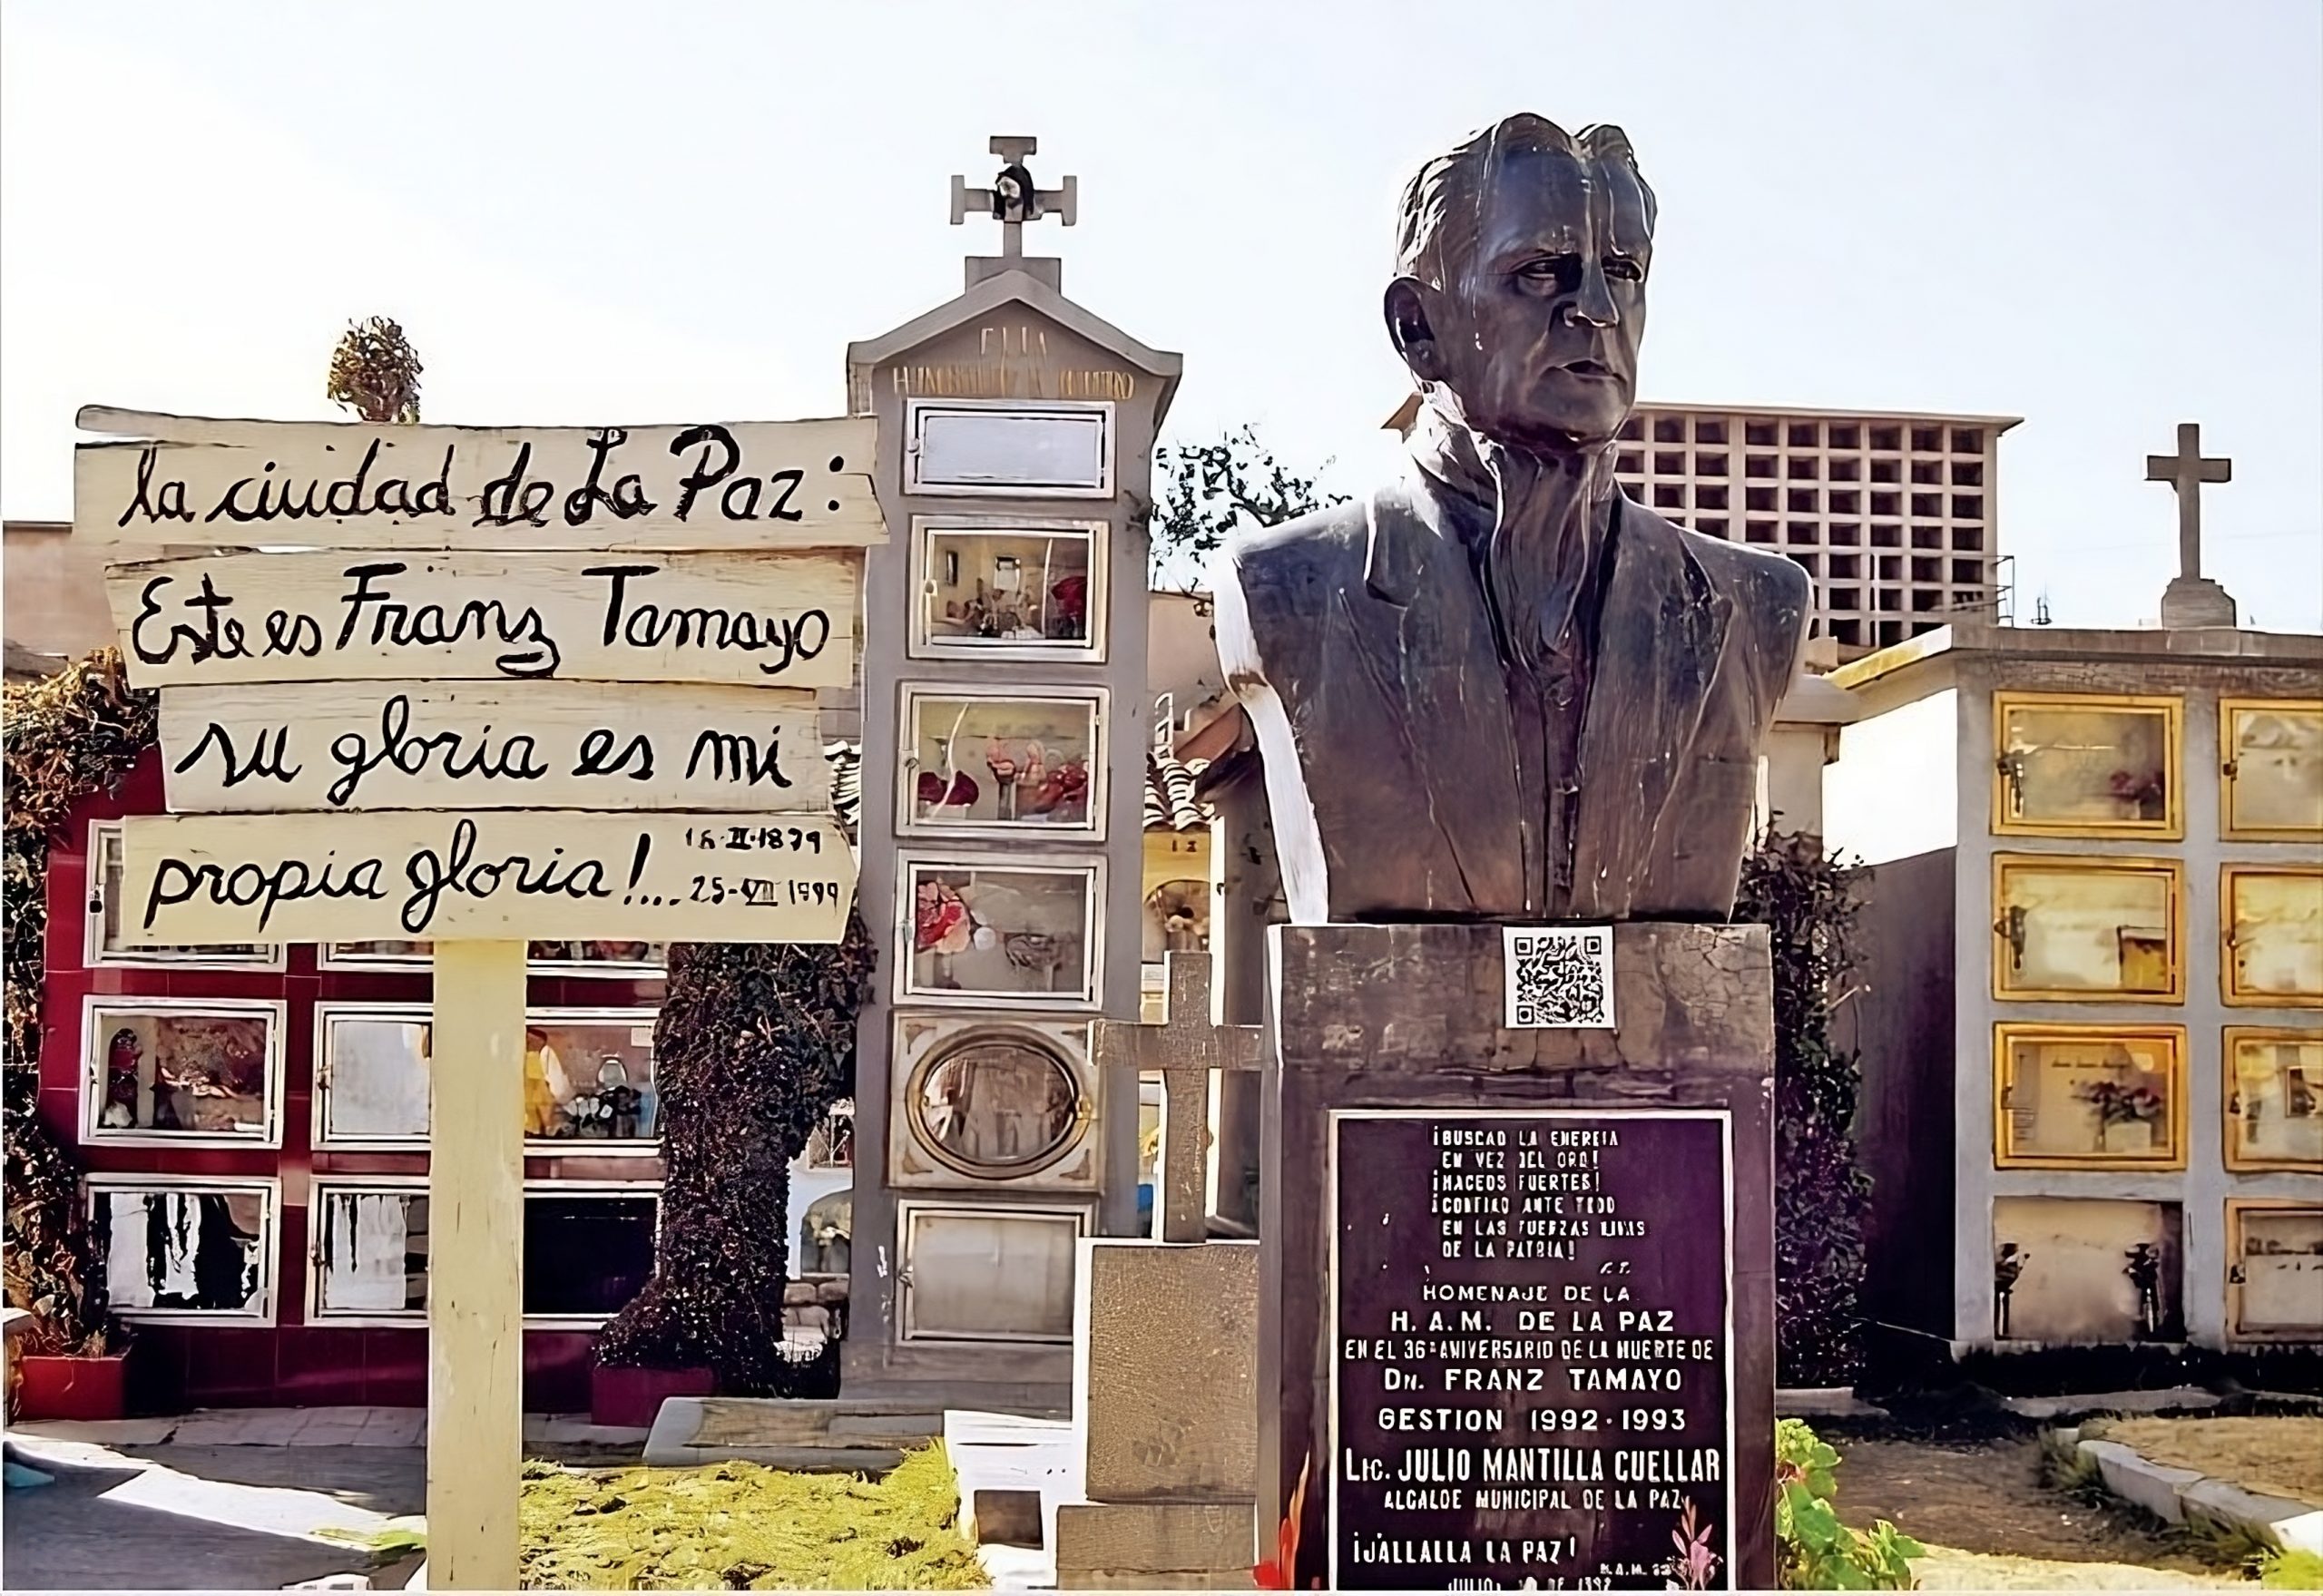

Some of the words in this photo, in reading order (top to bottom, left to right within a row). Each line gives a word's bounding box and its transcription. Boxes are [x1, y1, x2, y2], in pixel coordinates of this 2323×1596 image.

[204, 437, 457, 525] ciudad
[466, 441, 555, 527] de
[563, 426, 661, 528] La
[132, 572, 253, 666] Este
[261, 609, 323, 658] es
[335, 562, 562, 679] Franz
[581, 563, 831, 675] Tamayo
[173, 720, 303, 789] su
[326, 693, 550, 808] gloria
[571, 726, 654, 782] es
[684, 724, 793, 789] mi
[142, 850, 389, 934] propia
[1519, 1130, 1538, 1147] LA
[1442, 1150, 1463, 1169] EN
[1475, 1150, 1505, 1169] VEZ
[1522, 1196, 1563, 1214] ANTE
[1442, 1219, 1463, 1236] EN
[1475, 1219, 1506, 1236] LAS
[1442, 1240, 1462, 1258] DE
[1475, 1240, 1495, 1258] LA
[1423, 1284, 1547, 1303] HOMENAJE
[1563, 1285, 1593, 1302] DE
[1603, 1286, 1630, 1303] LA
[1519, 1311, 1555, 1331] DE
[1573, 1310, 1604, 1332] LA
[1619, 1310, 1674, 1332] PAZ
[1345, 1338, 1367, 1359] EN
[1374, 1339, 1397, 1360] EL
[1439, 1339, 1554, 1359] ANIVERSARIO
[1561, 1339, 1583, 1360] DE
[1589, 1339, 1609, 1359] LA
[1616, 1339, 1686, 1360] MUERTE
[1691, 1339, 1713, 1360] DE
[1445, 1368, 1544, 1391] FRANZ
[1569, 1367, 1681, 1391] TAMAYO
[1378, 1407, 1503, 1432] GESTION
[1397, 1447, 1471, 1483] JULIO
[1483, 1447, 1604, 1483] MANTILLA
[1614, 1448, 1720, 1483] CUELLAR
[1384, 1488, 1462, 1511] ALCALDE
[1475, 1488, 1572, 1511] MUNICIPAL
[1583, 1489, 1604, 1511] DE
[1614, 1490, 1638, 1510] LA
[1649, 1488, 1681, 1510] PAZ
[1486, 1541, 1511, 1563] LA
